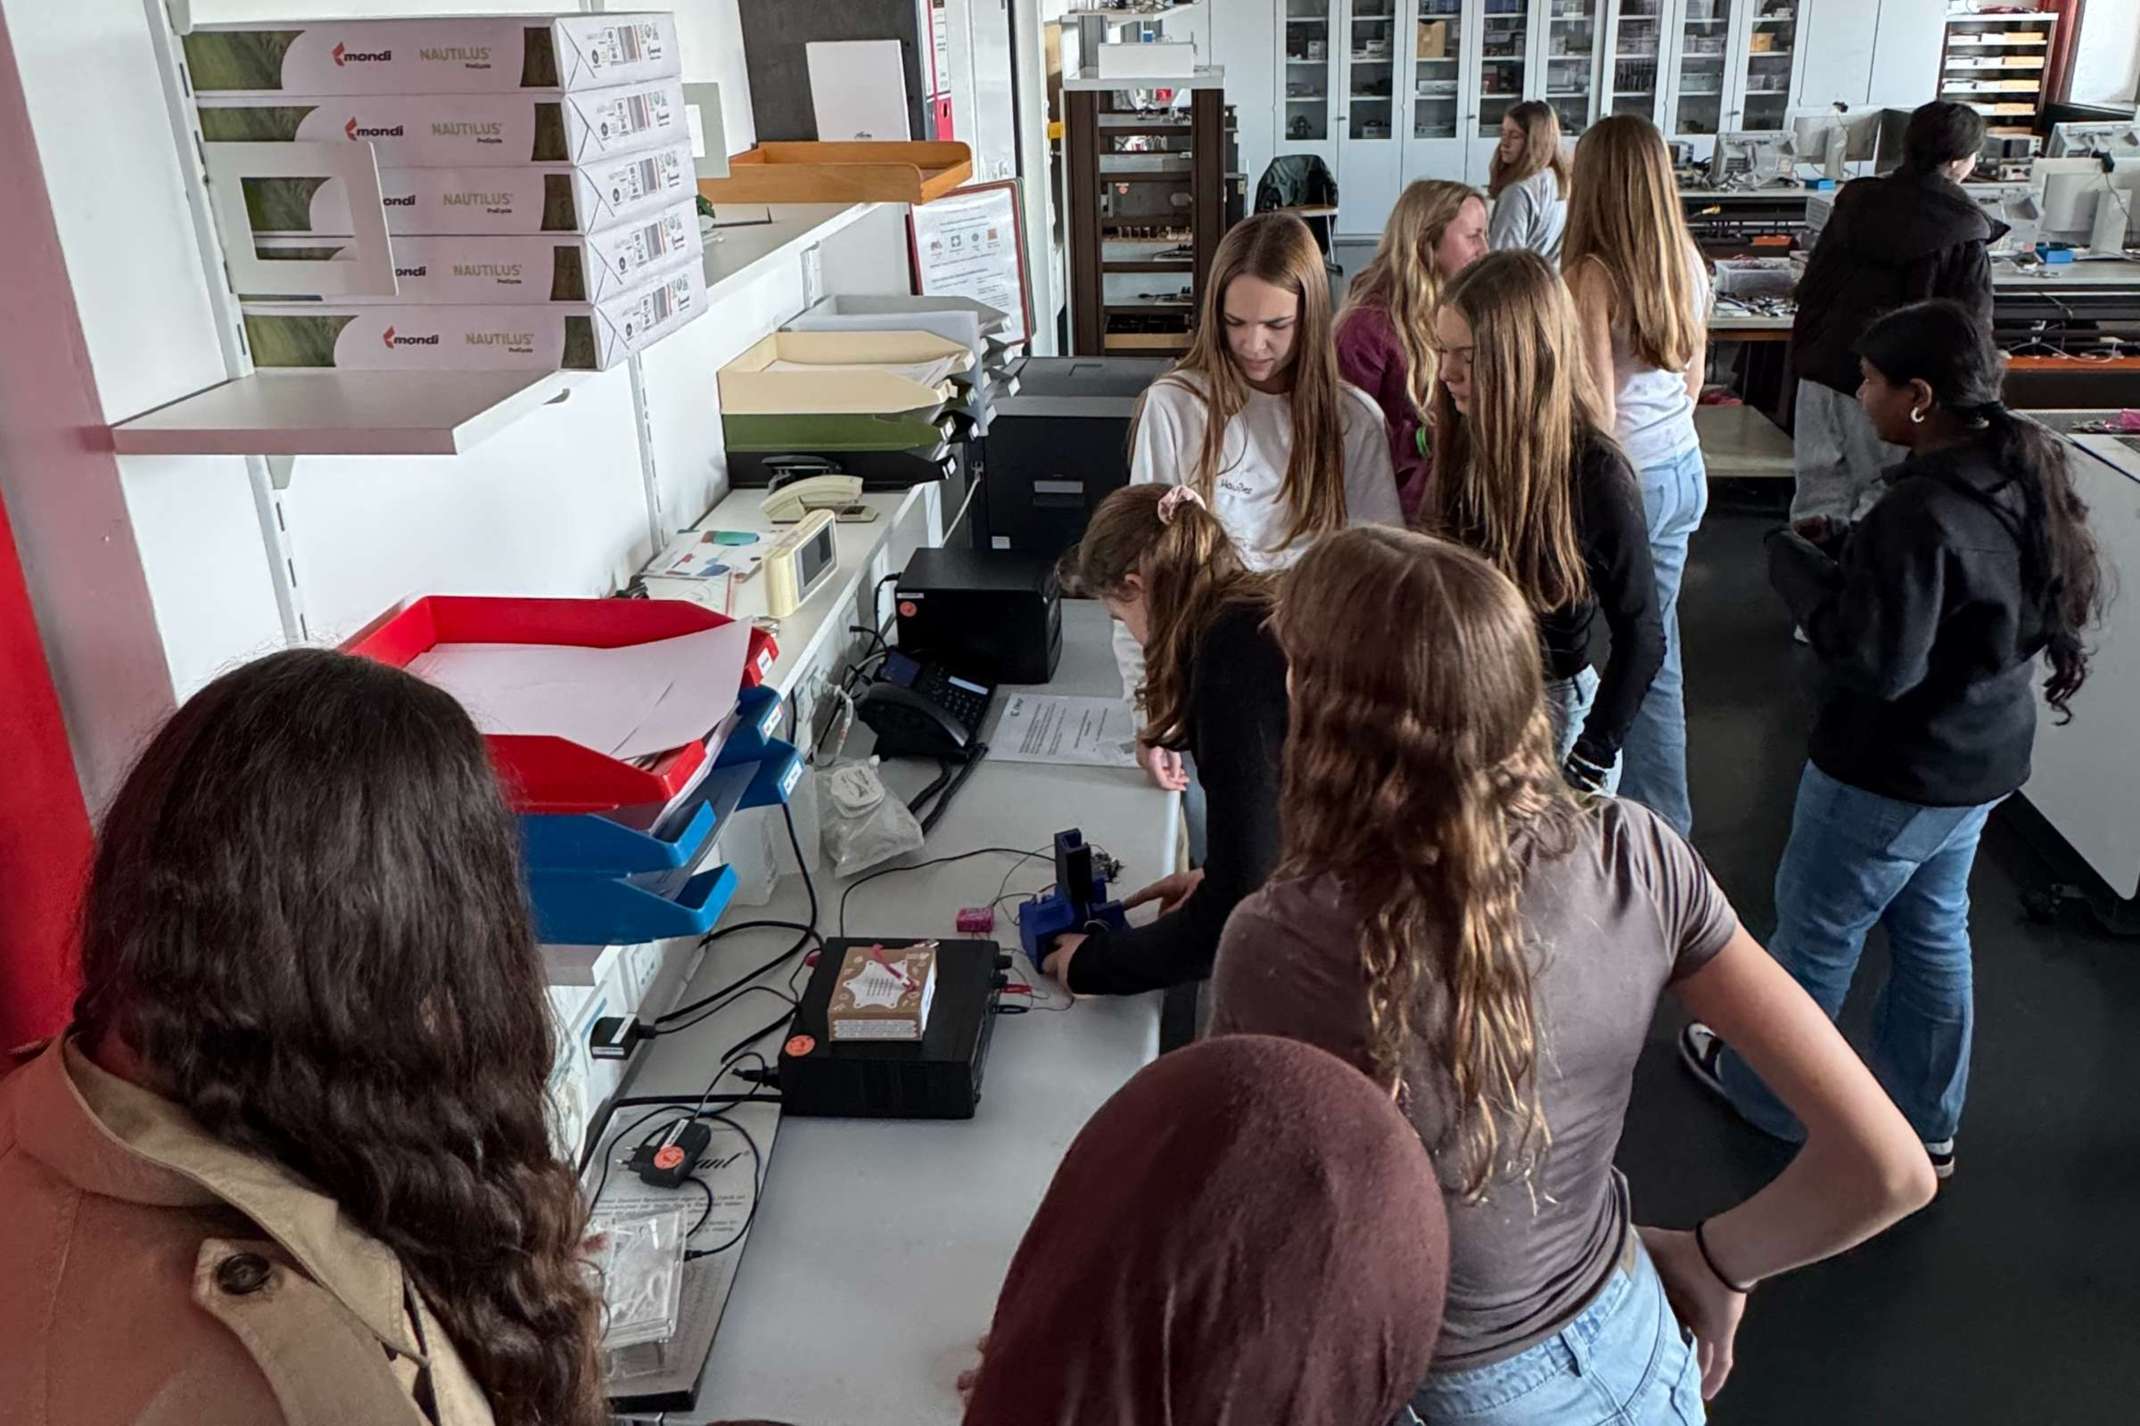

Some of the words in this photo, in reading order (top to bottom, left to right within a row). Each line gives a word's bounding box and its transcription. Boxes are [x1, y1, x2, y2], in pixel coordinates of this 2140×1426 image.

[343, 50, 392, 62] mondi
[419, 47, 490, 61] NAUTILUS
[356, 124, 404, 137] mondi
[431, 122, 501, 135] NAUTILUS
[383, 194, 416, 207] ondi
[442, 192, 511, 206] NAUTILUS
[395, 266, 426, 277] ondi
[452, 263, 521, 277] NAUTILUS
[393, 334, 439, 346] mondi
[465, 332, 532, 346] NAUTILUS
